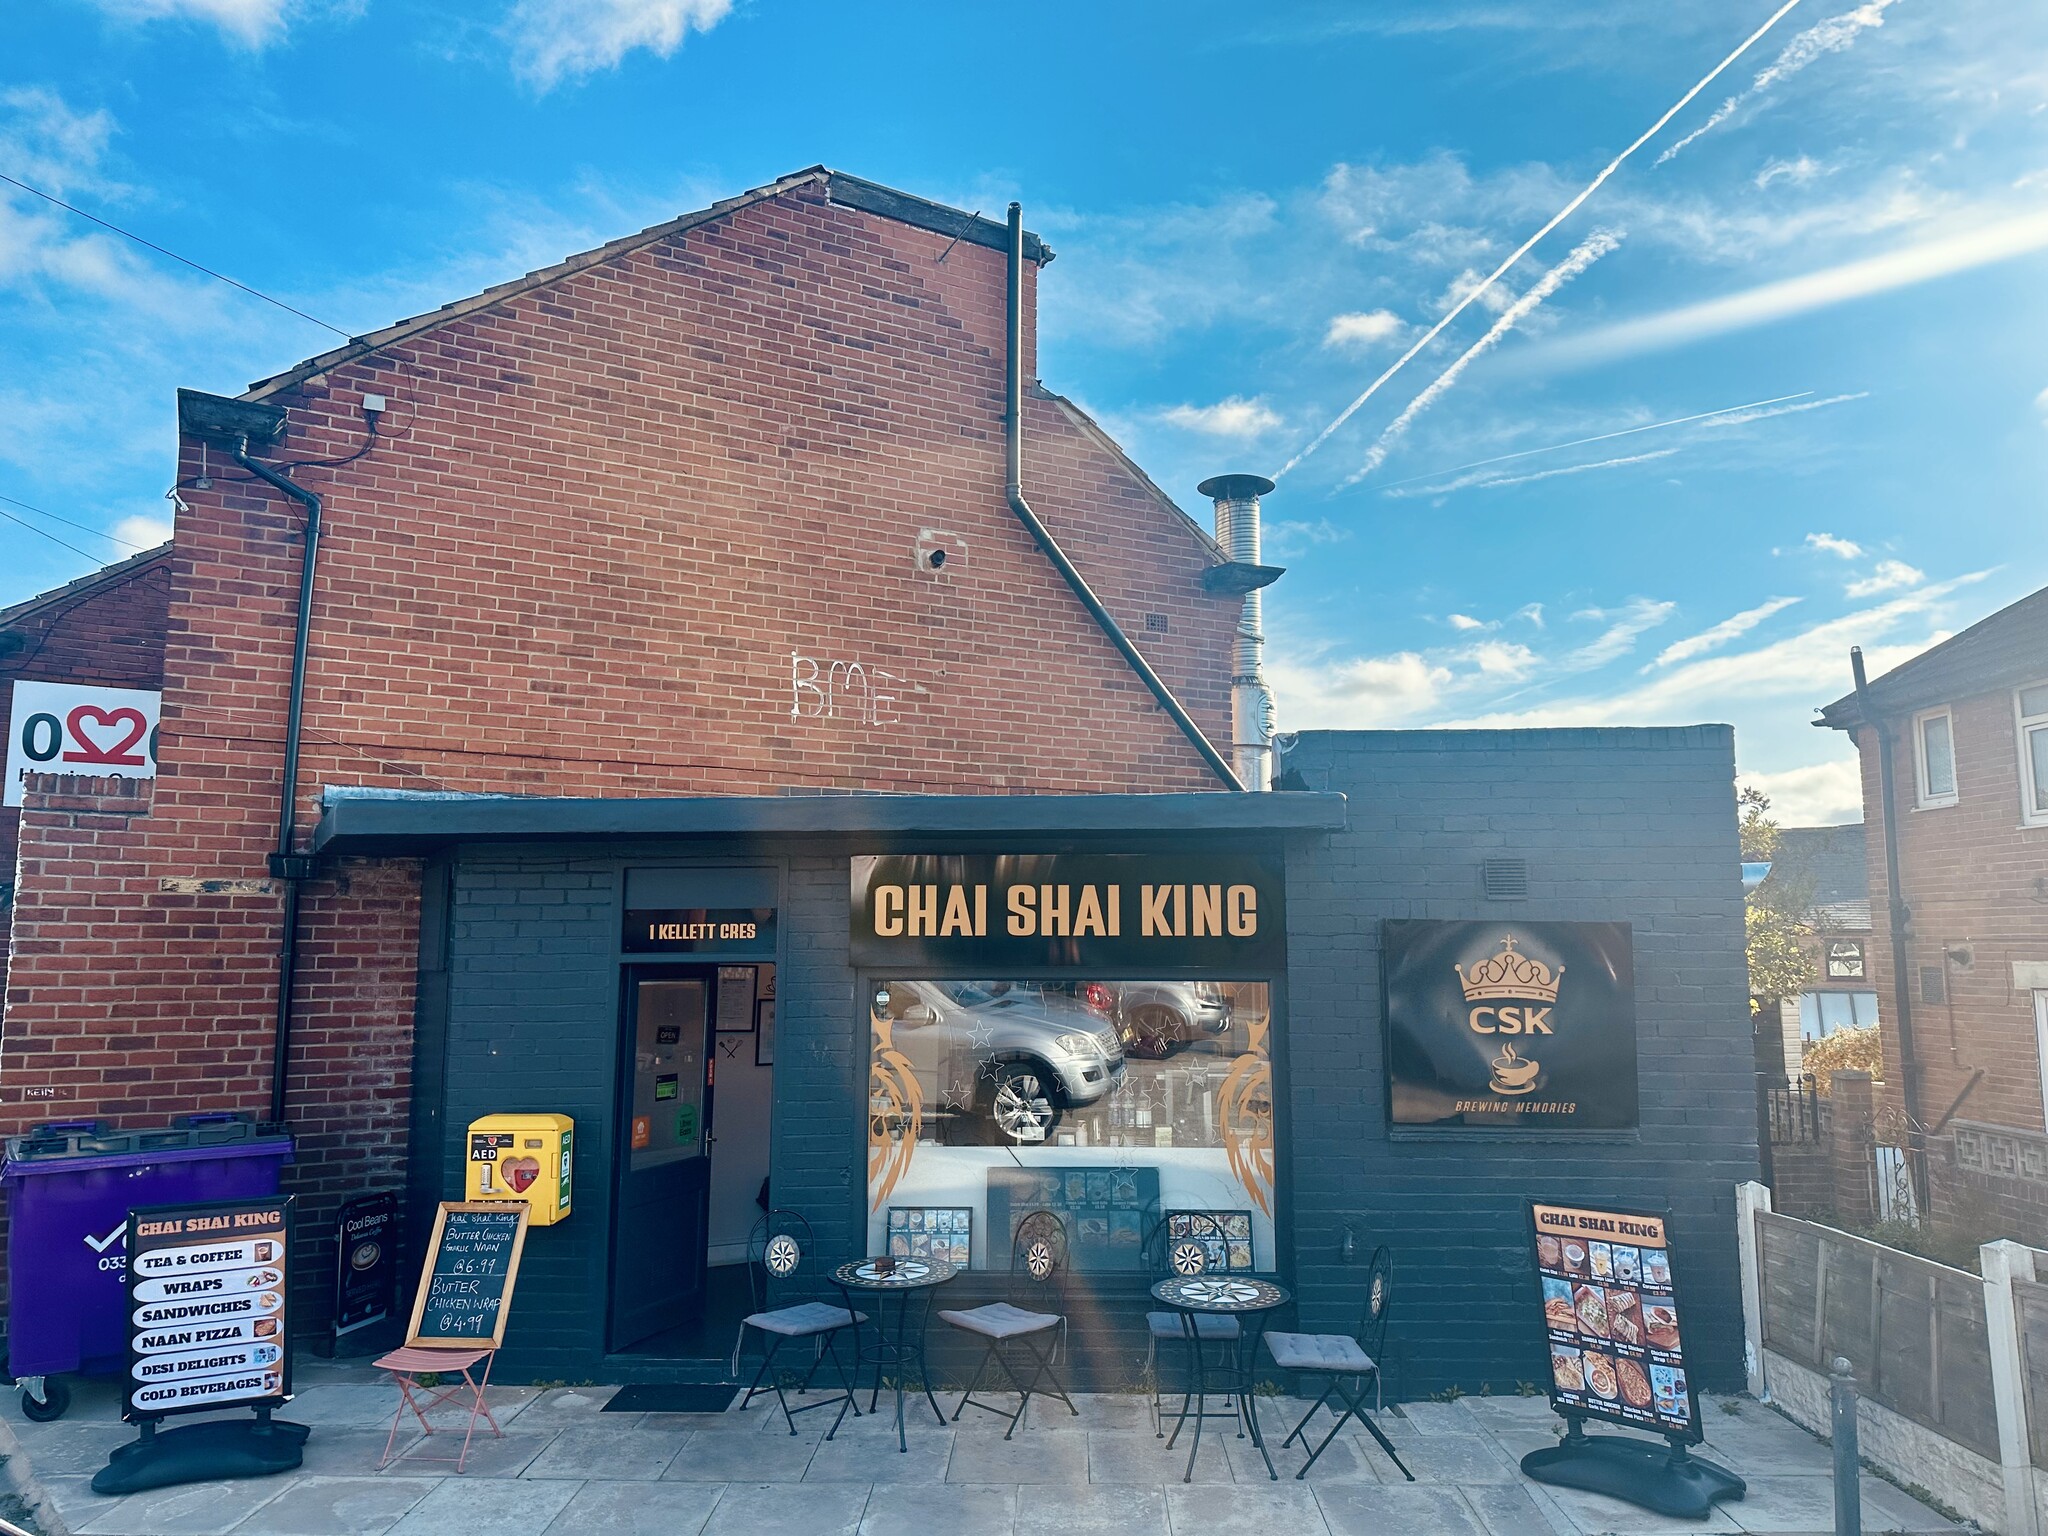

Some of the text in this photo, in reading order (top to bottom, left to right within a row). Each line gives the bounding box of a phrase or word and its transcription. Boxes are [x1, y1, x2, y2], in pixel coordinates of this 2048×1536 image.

[874, 884, 1257, 937] CHAI SHAI KING
[649, 923, 756, 940] 1 KELLETT CRES
[1469, 1006, 1554, 1035] CSK
[660, 1031, 676, 1040] OPEN
[1455, 1100, 1576, 1114] BREWING MEMORIES
[472, 1149, 497, 1160] AED
[137, 1211, 281, 1237] CHAI SHAI KING
[347, 1213, 389, 1232] Cool Beans
[1540, 1212, 1659, 1238] CHAI SHAI KING
[144, 1249, 243, 1269] TEA & COFFEE
[163, 1279, 223, 1295] WRAPS
[432, 1276, 480, 1295] BUTTER
[142, 1300, 252, 1322] SANDWICHES
[427, 1296, 502, 1312] CHICKEN WRAP
[142, 1326, 243, 1349] NAAN PIZZA
[142, 1354, 246, 1377] DESI DELIGHTS
[140, 1378, 262, 1402] COLD BEVERAGES
